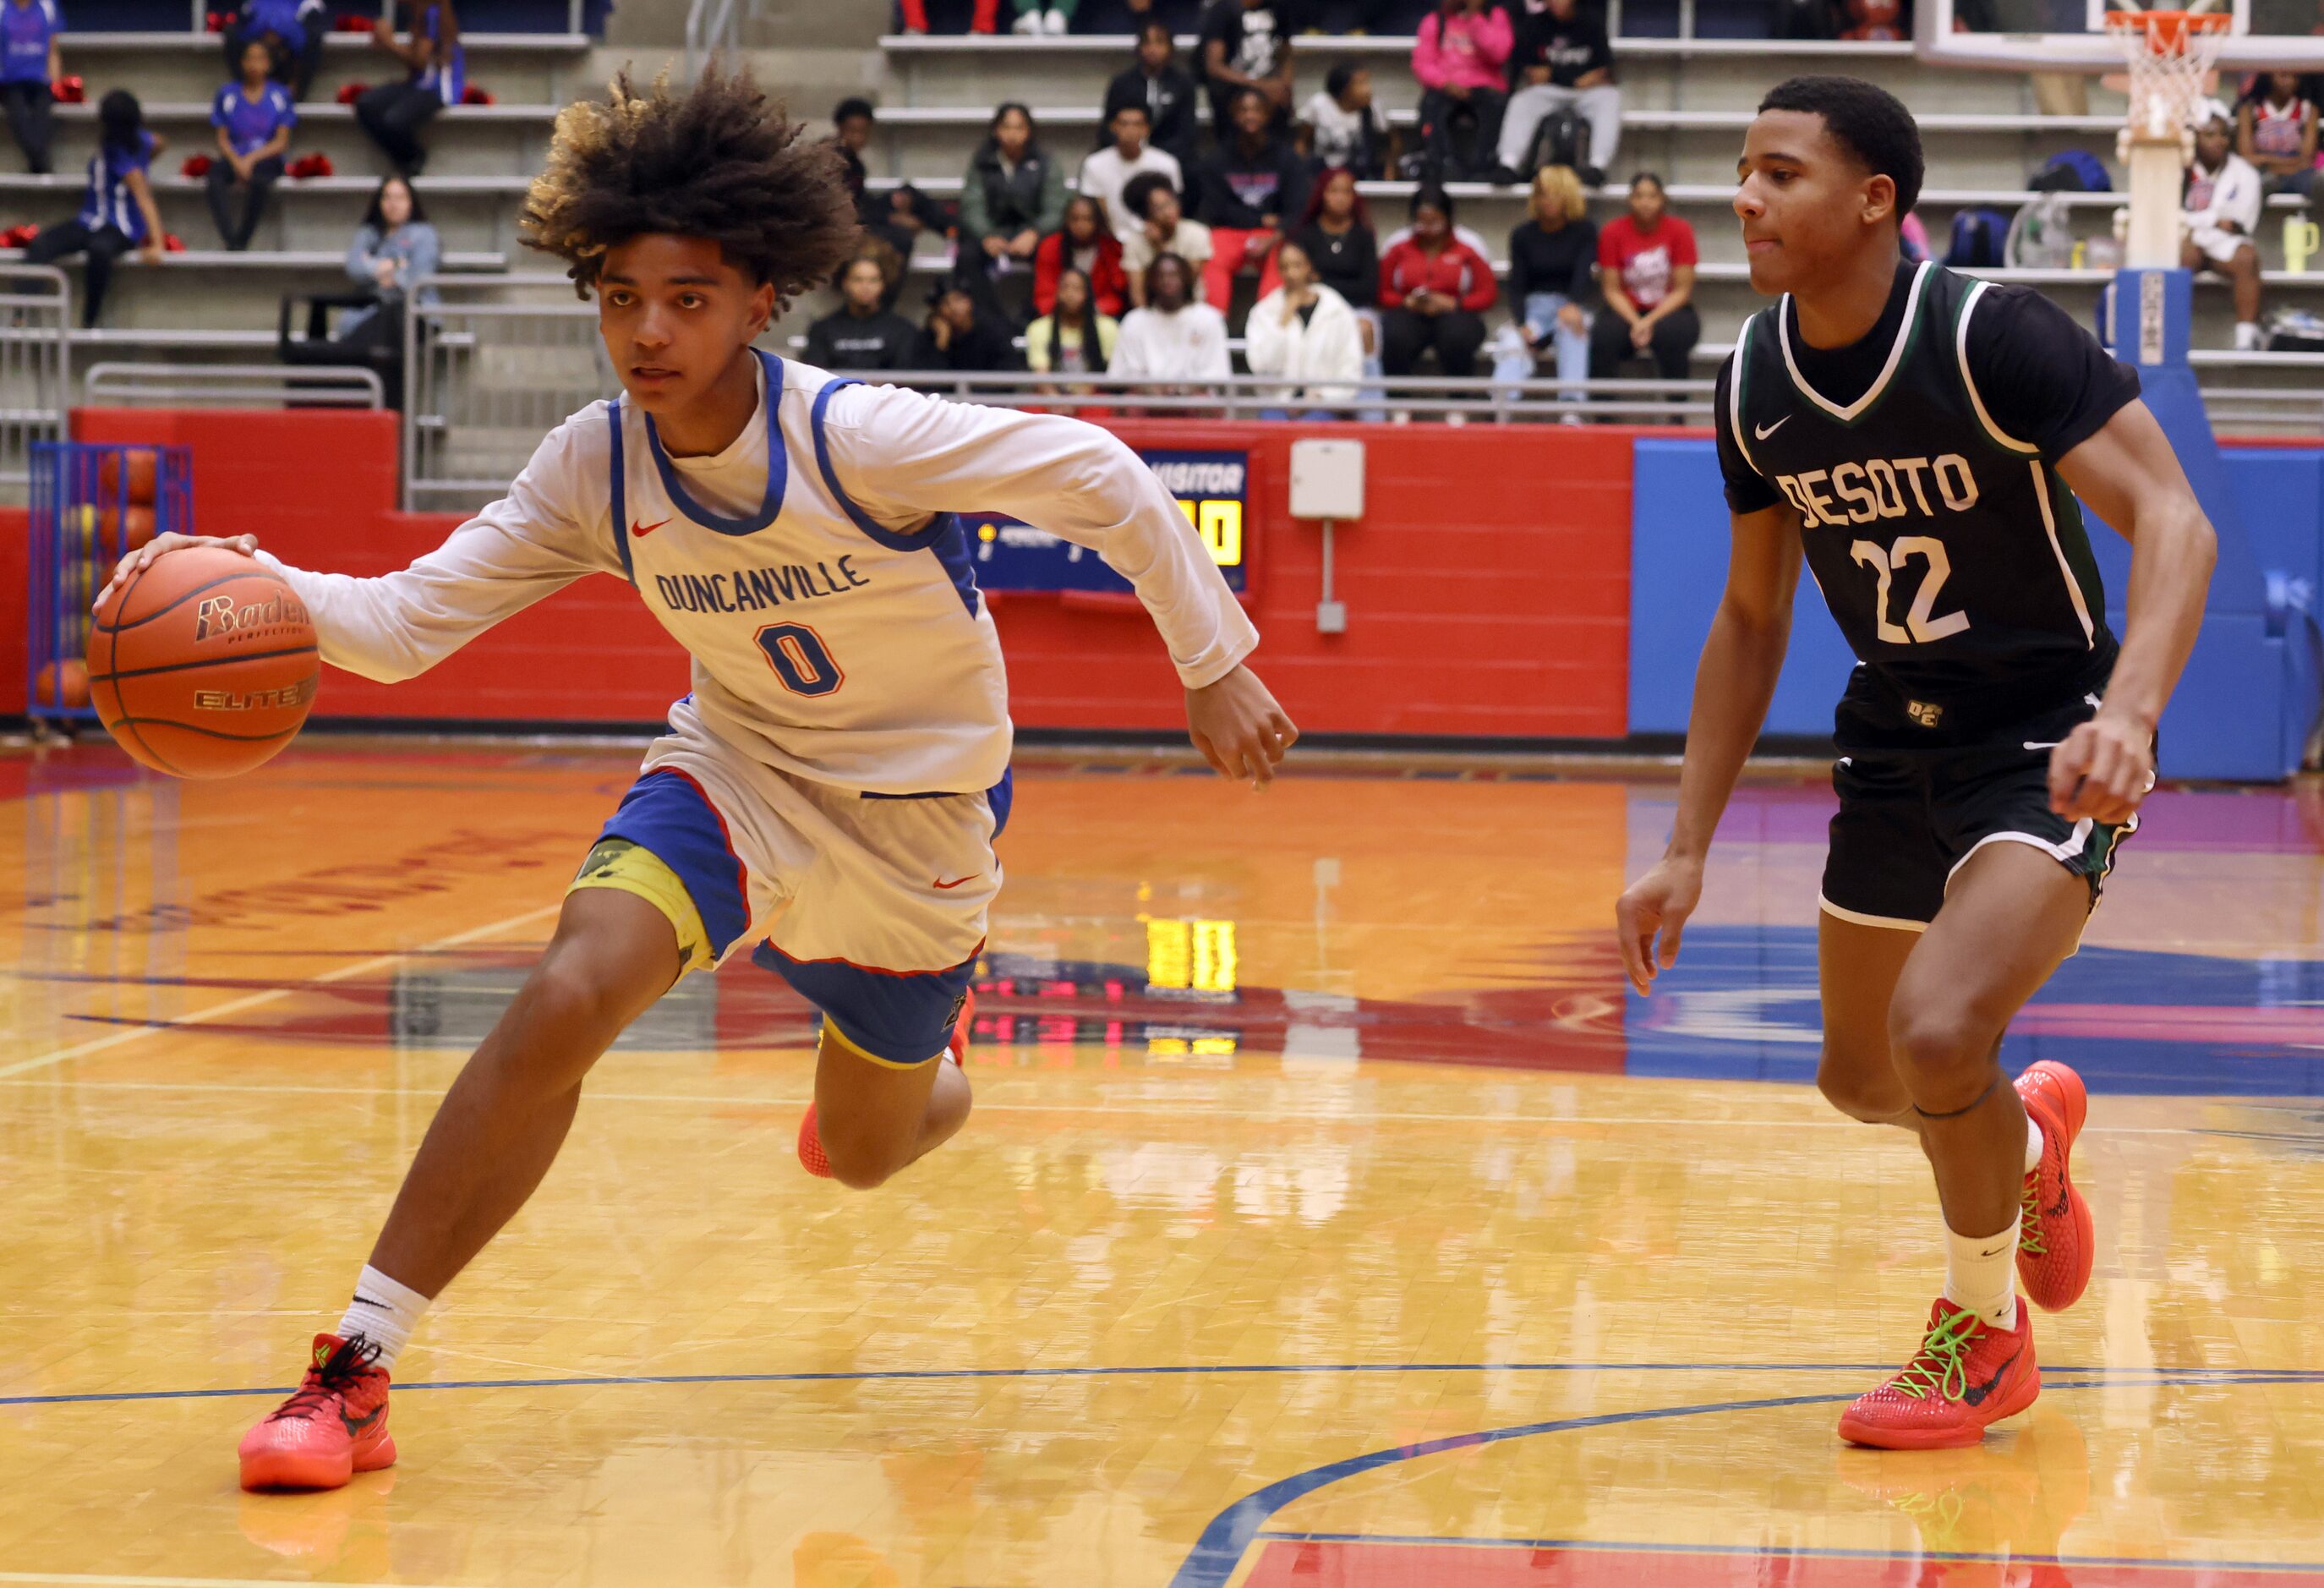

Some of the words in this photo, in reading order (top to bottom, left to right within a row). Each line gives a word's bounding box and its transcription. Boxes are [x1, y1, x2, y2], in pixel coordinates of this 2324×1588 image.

[1774, 453, 1979, 528] DESOTO
[194, 589, 311, 643] Baden
[655, 554, 871, 614] DUNCANVILLE
[1850, 535, 1971, 644] 22
[752, 621, 845, 698] 0
[194, 686, 299, 711] ELITE
